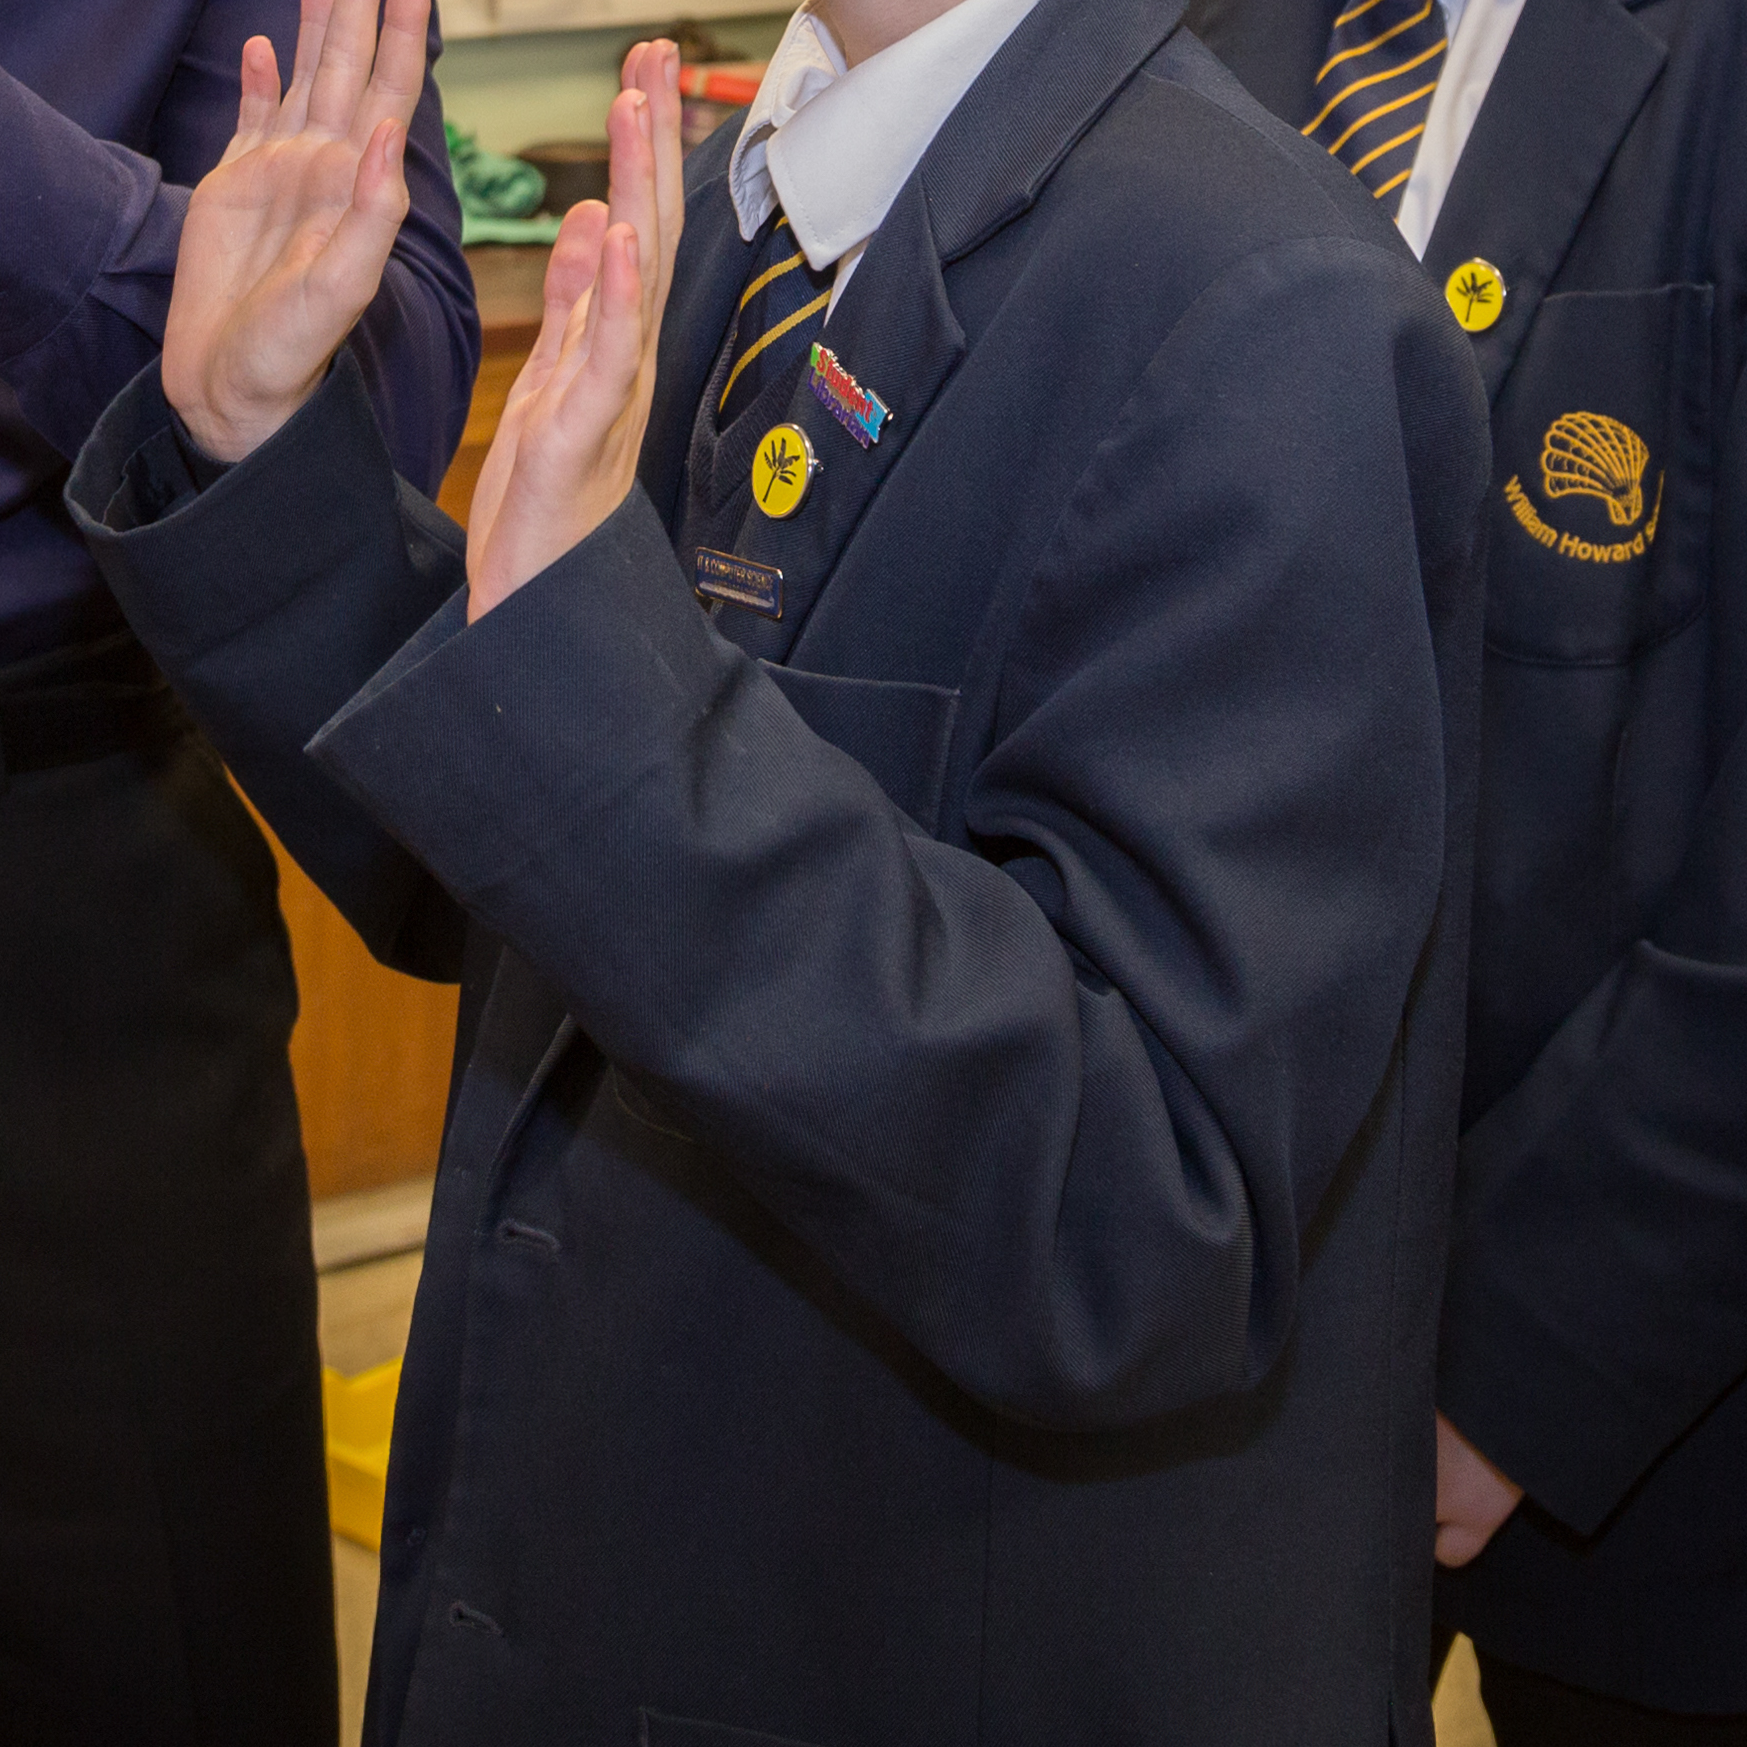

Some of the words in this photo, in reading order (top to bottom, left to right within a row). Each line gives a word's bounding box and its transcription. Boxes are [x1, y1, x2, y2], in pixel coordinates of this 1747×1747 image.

[806, 366, 872, 451] Librarian
[815, 347, 875, 424] Student
[1504, 473, 1559, 549] William
[1557, 531, 1646, 564] Howard
